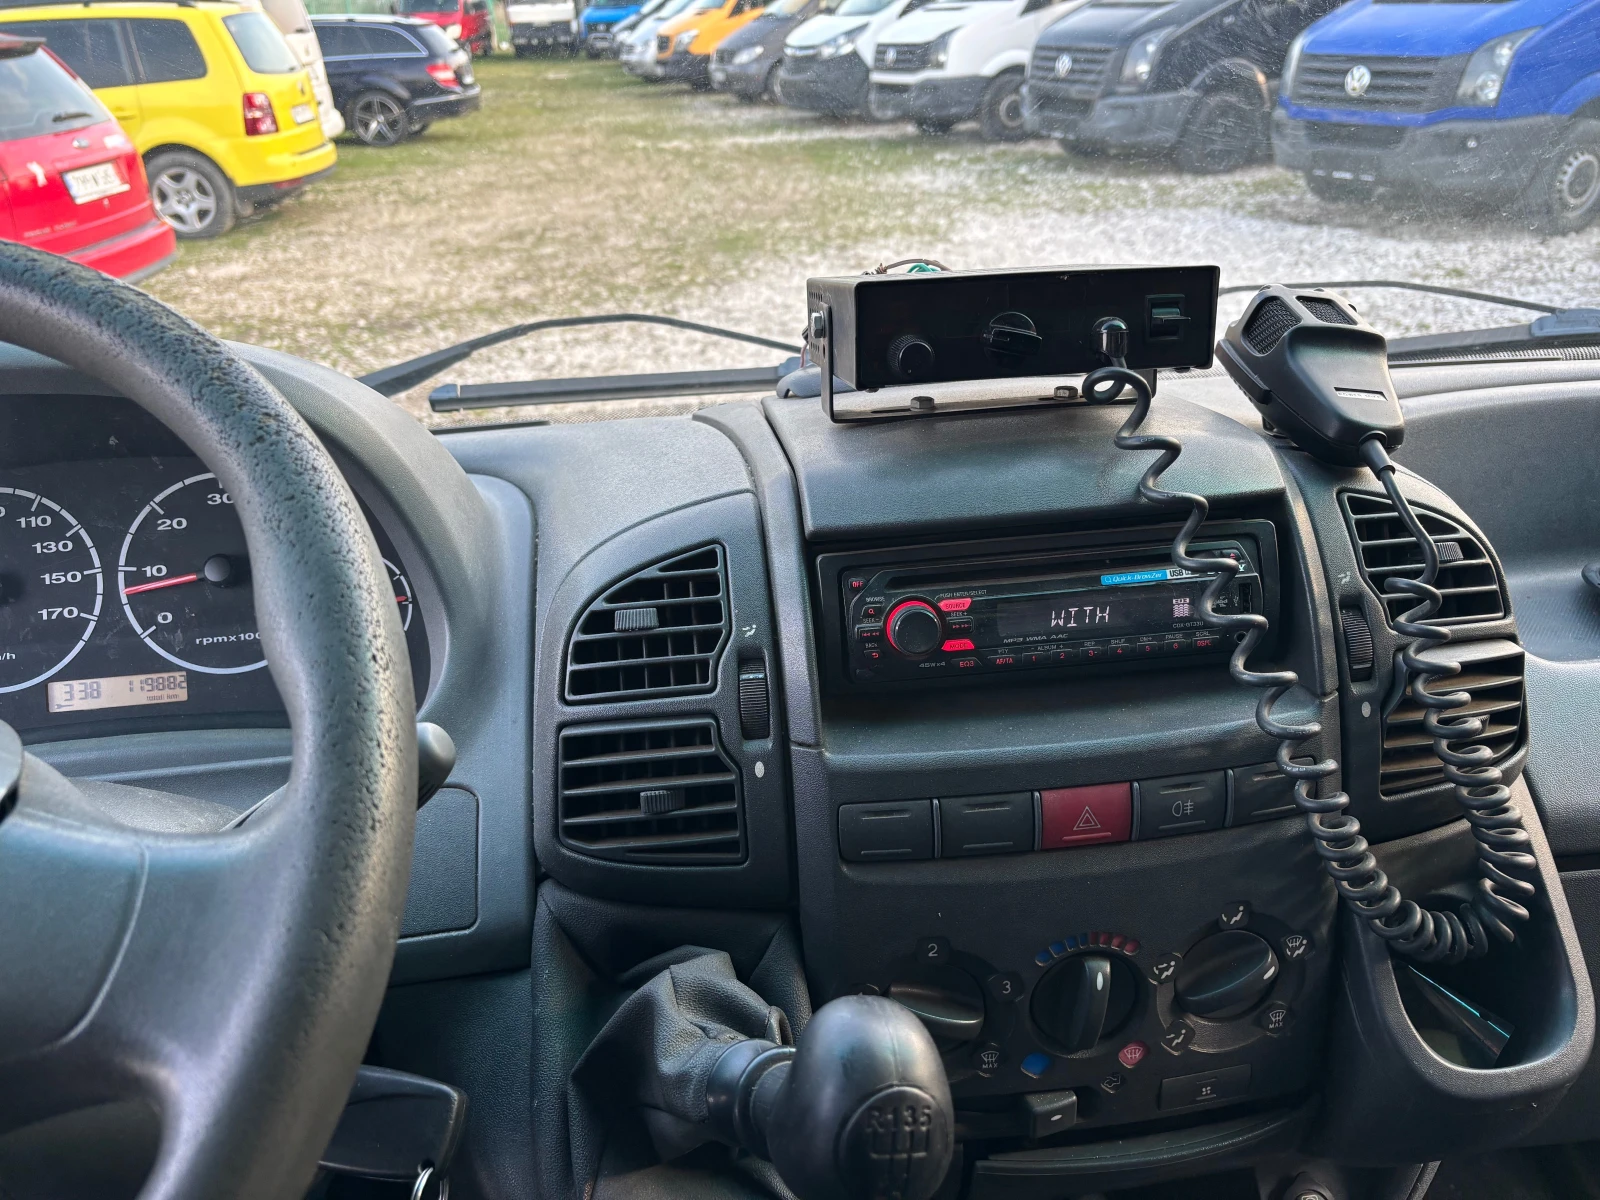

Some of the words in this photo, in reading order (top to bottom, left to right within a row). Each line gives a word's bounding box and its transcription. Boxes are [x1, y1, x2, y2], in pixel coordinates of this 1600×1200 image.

[16, 515, 52, 528] 110
[157, 517, 187, 530] 20
[32, 540, 73, 553] 130
[40, 571, 82, 584] 150
[142, 565, 167, 577] 10
[1169, 569, 1184, 578] USB
[852, 580, 864, 588] OFF
[38, 606, 78, 620] 170
[157, 612, 173, 624] 0
[1051, 605, 1111, 628] WITH
[927, 943, 938, 957] 2
[1002, 980, 1011, 994] 3
[1268, 1021, 1284, 1029] MAX
